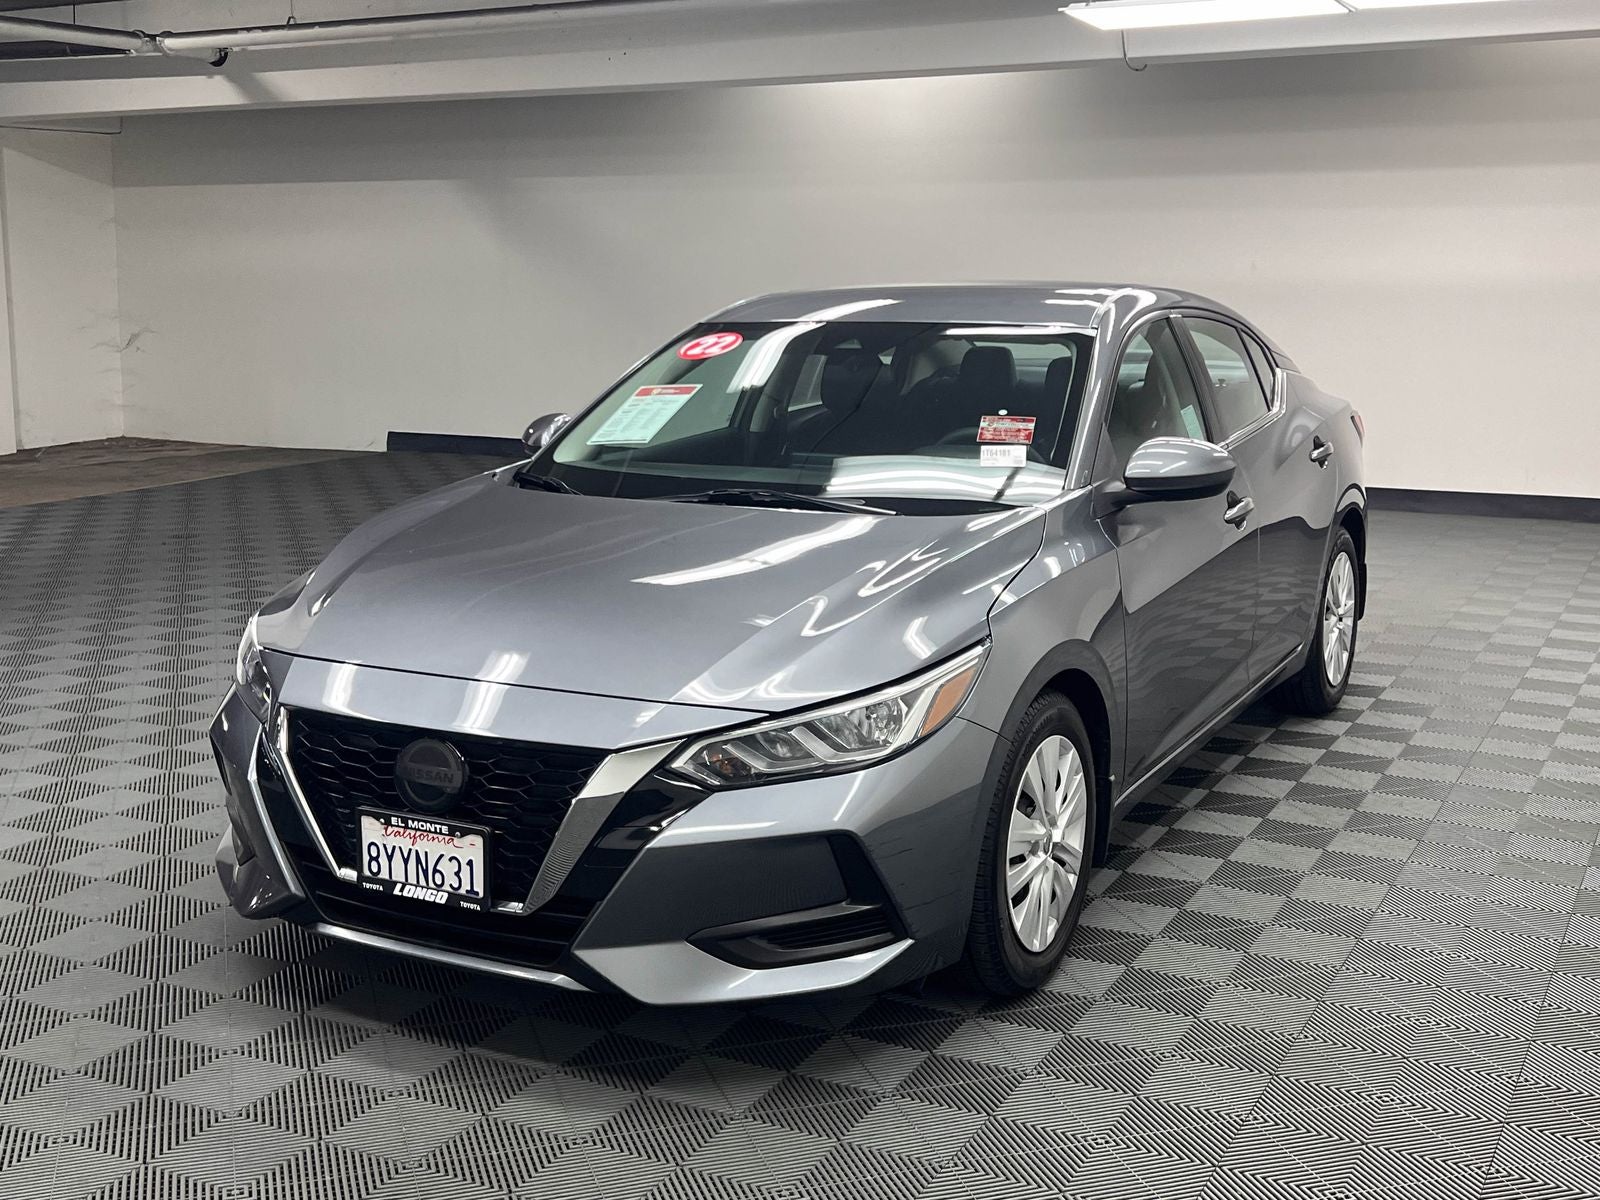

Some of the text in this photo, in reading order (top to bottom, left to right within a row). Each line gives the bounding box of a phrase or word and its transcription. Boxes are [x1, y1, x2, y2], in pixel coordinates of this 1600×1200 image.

[686, 335, 737, 356] 22
[391, 817, 449, 834] EL MONTE
[384, 825, 464, 848] California
[367, 841, 480, 896] 8YYN631
[362, 882, 384, 891] TOYOTA
[393, 883, 449, 904] LONGO
[460, 901, 481, 911] TOYOTA
